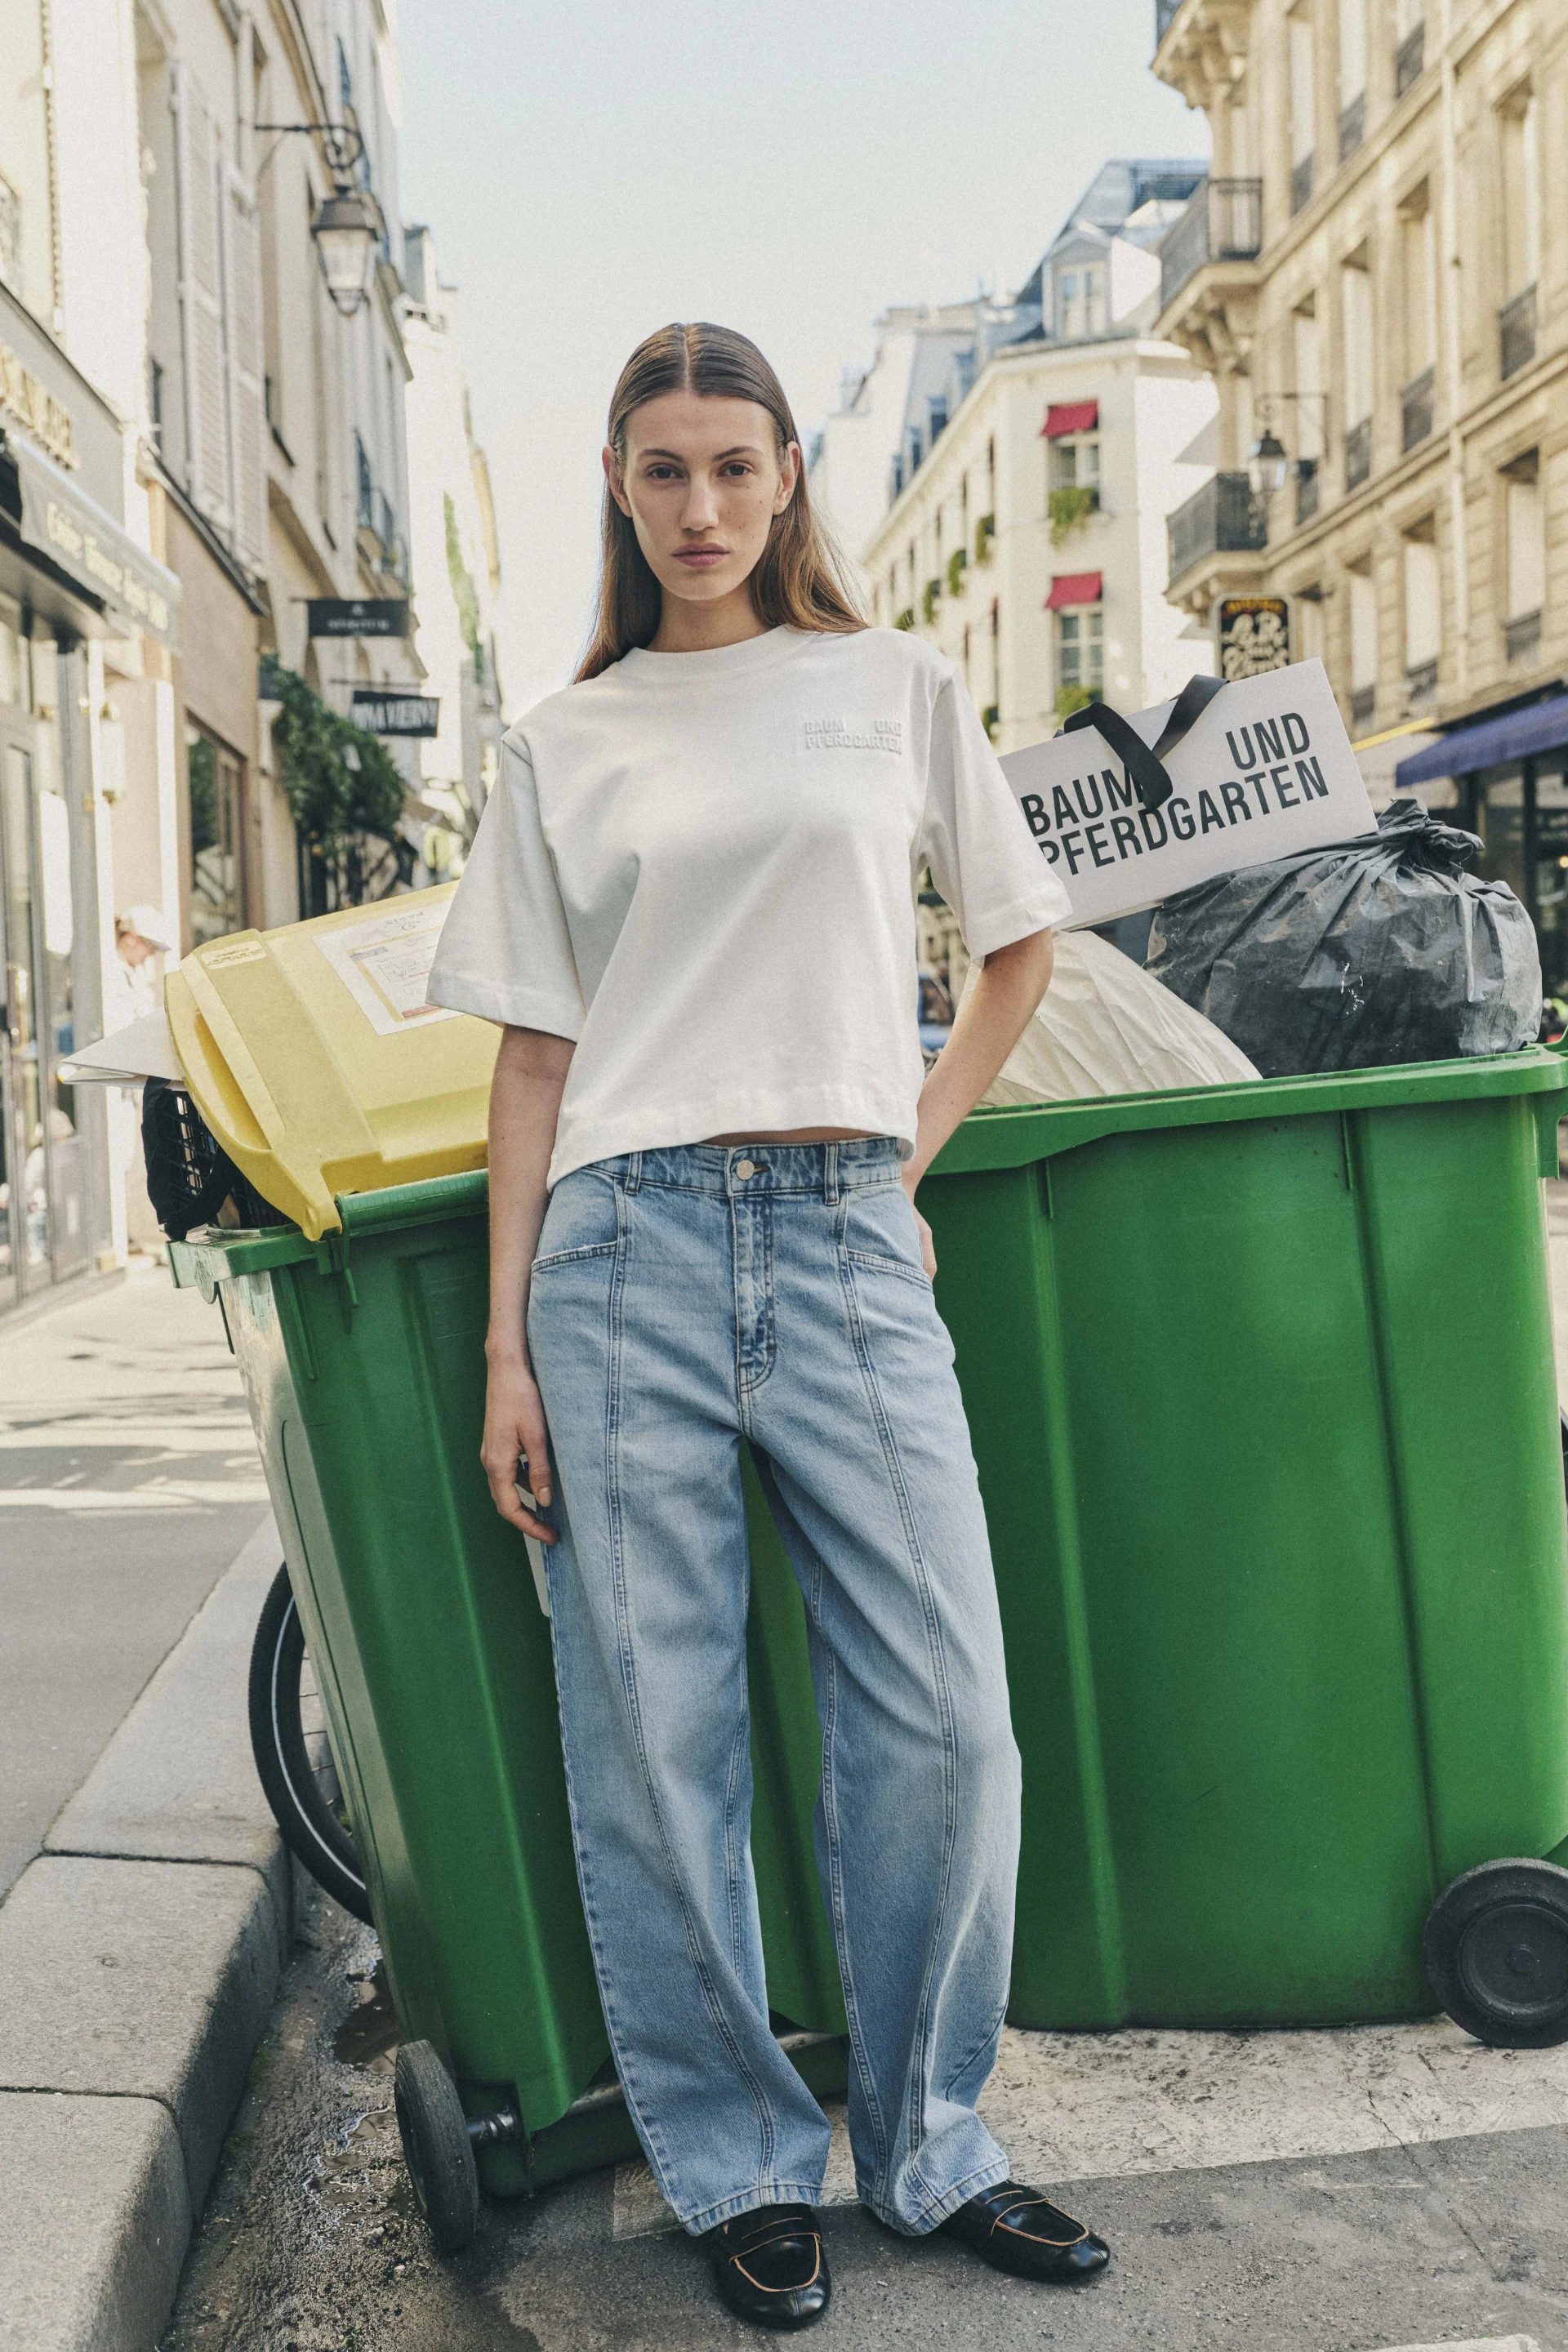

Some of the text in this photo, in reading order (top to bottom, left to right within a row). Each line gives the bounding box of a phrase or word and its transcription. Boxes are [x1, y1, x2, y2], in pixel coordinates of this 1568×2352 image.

[804, 719, 903, 736] BAUM UND
[1020, 712, 1311, 837] BAUM UND
[1038, 755, 1330, 875] PFERDGARTEN
